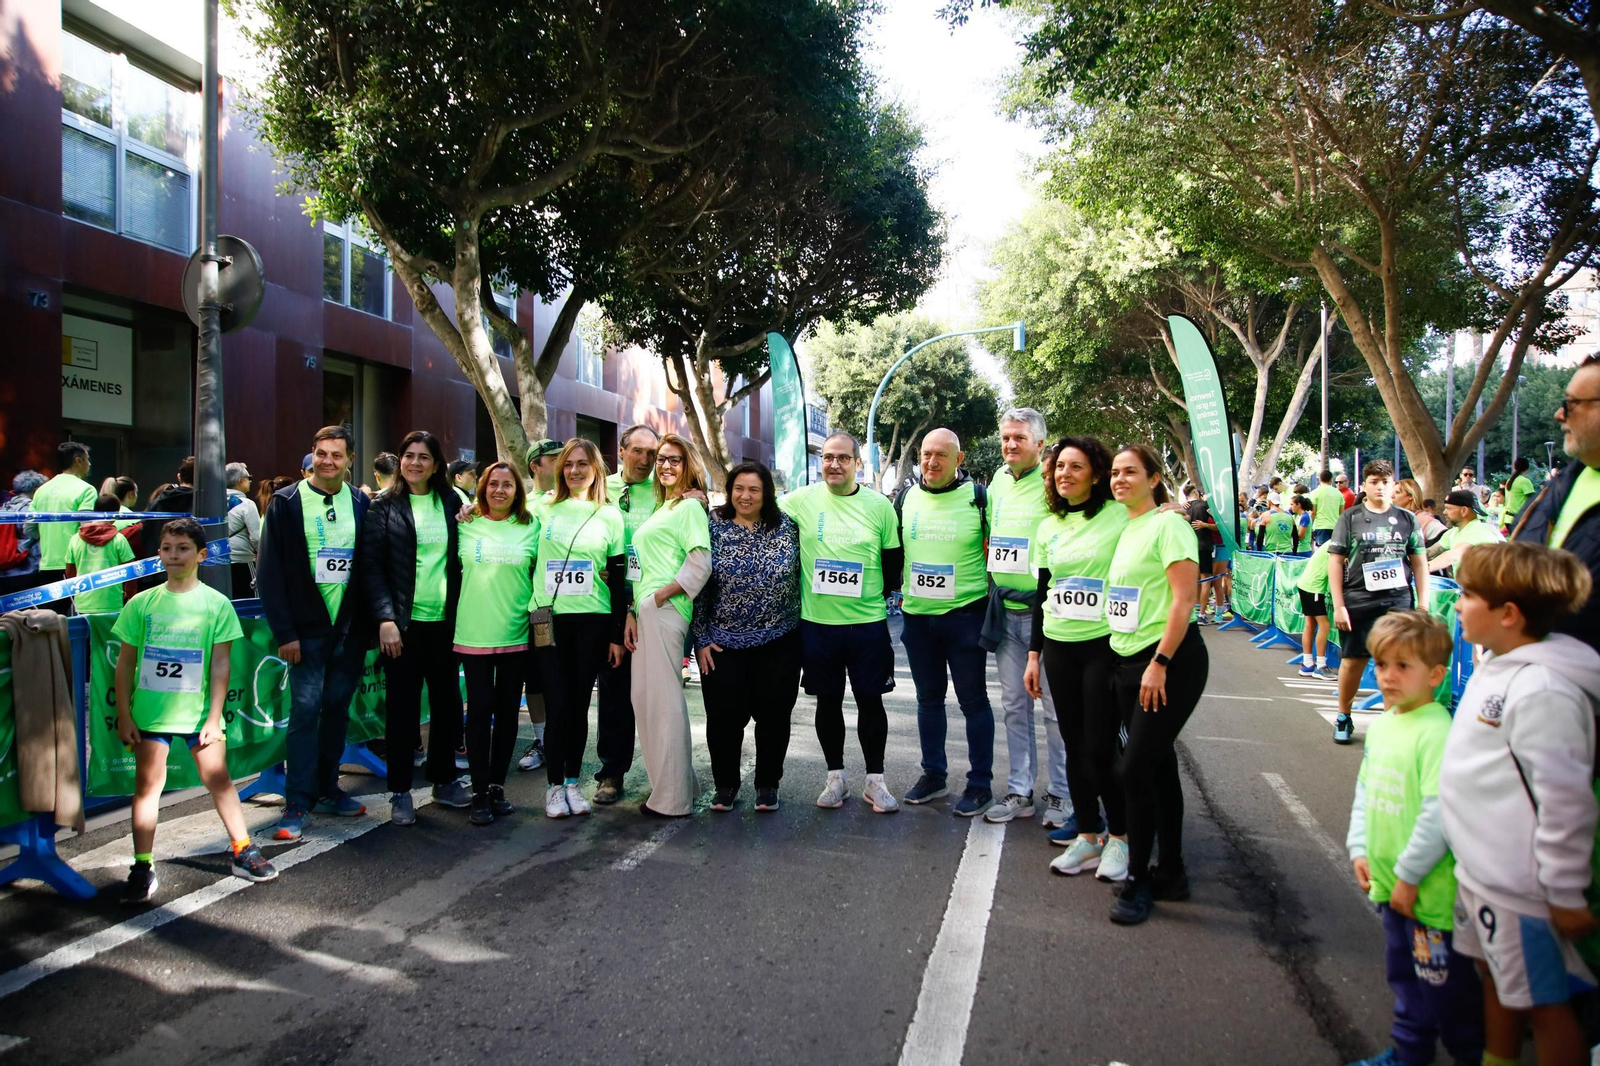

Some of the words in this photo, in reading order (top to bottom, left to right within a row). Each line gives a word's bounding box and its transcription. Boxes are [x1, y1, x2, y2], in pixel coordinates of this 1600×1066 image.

[29, 291, 49, 308] 73
[61, 375, 122, 396] XÁMENES
[1362, 532, 1402, 540] IDESA
[995, 548, 1018, 562] 871
[554, 572, 584, 584] 816
[818, 570, 858, 586] 1564
[917, 574, 946, 588] 852
[1372, 569, 1397, 581] 988
[1054, 590, 1098, 606] 1600
[156, 662, 182, 678] 52
[1479, 904, 1496, 944] 9
